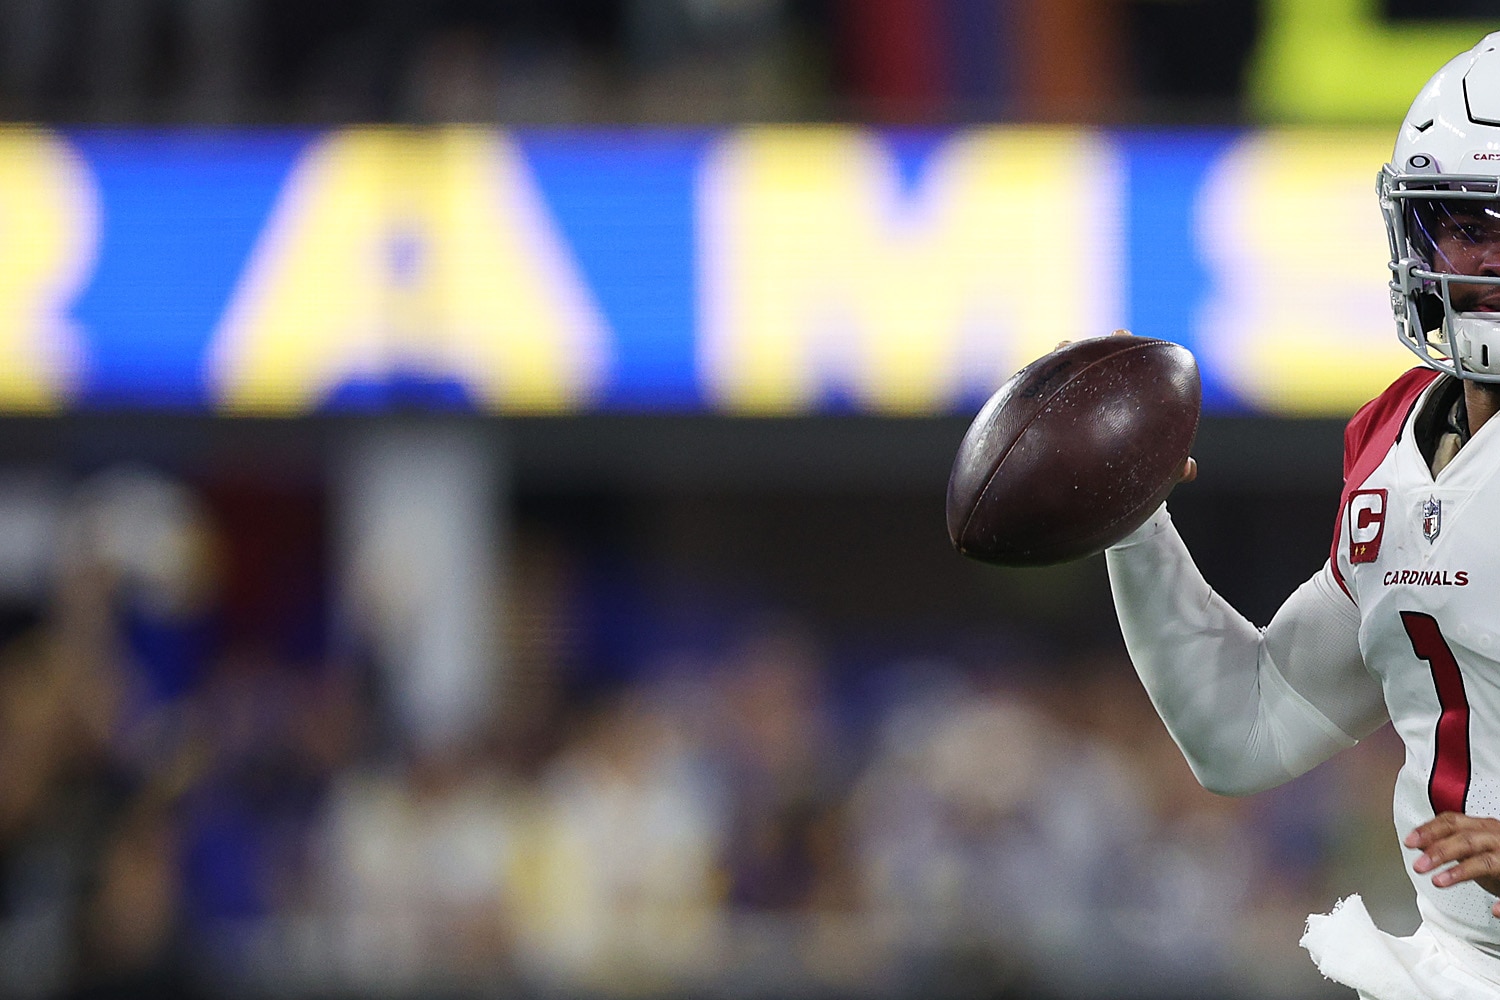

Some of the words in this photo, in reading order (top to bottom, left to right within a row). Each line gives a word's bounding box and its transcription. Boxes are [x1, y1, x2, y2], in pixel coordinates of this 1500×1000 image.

[1350, 493, 1383, 544] C
[1383, 569, 1469, 587] CARDINALS
[1398, 610, 1471, 817] 1
